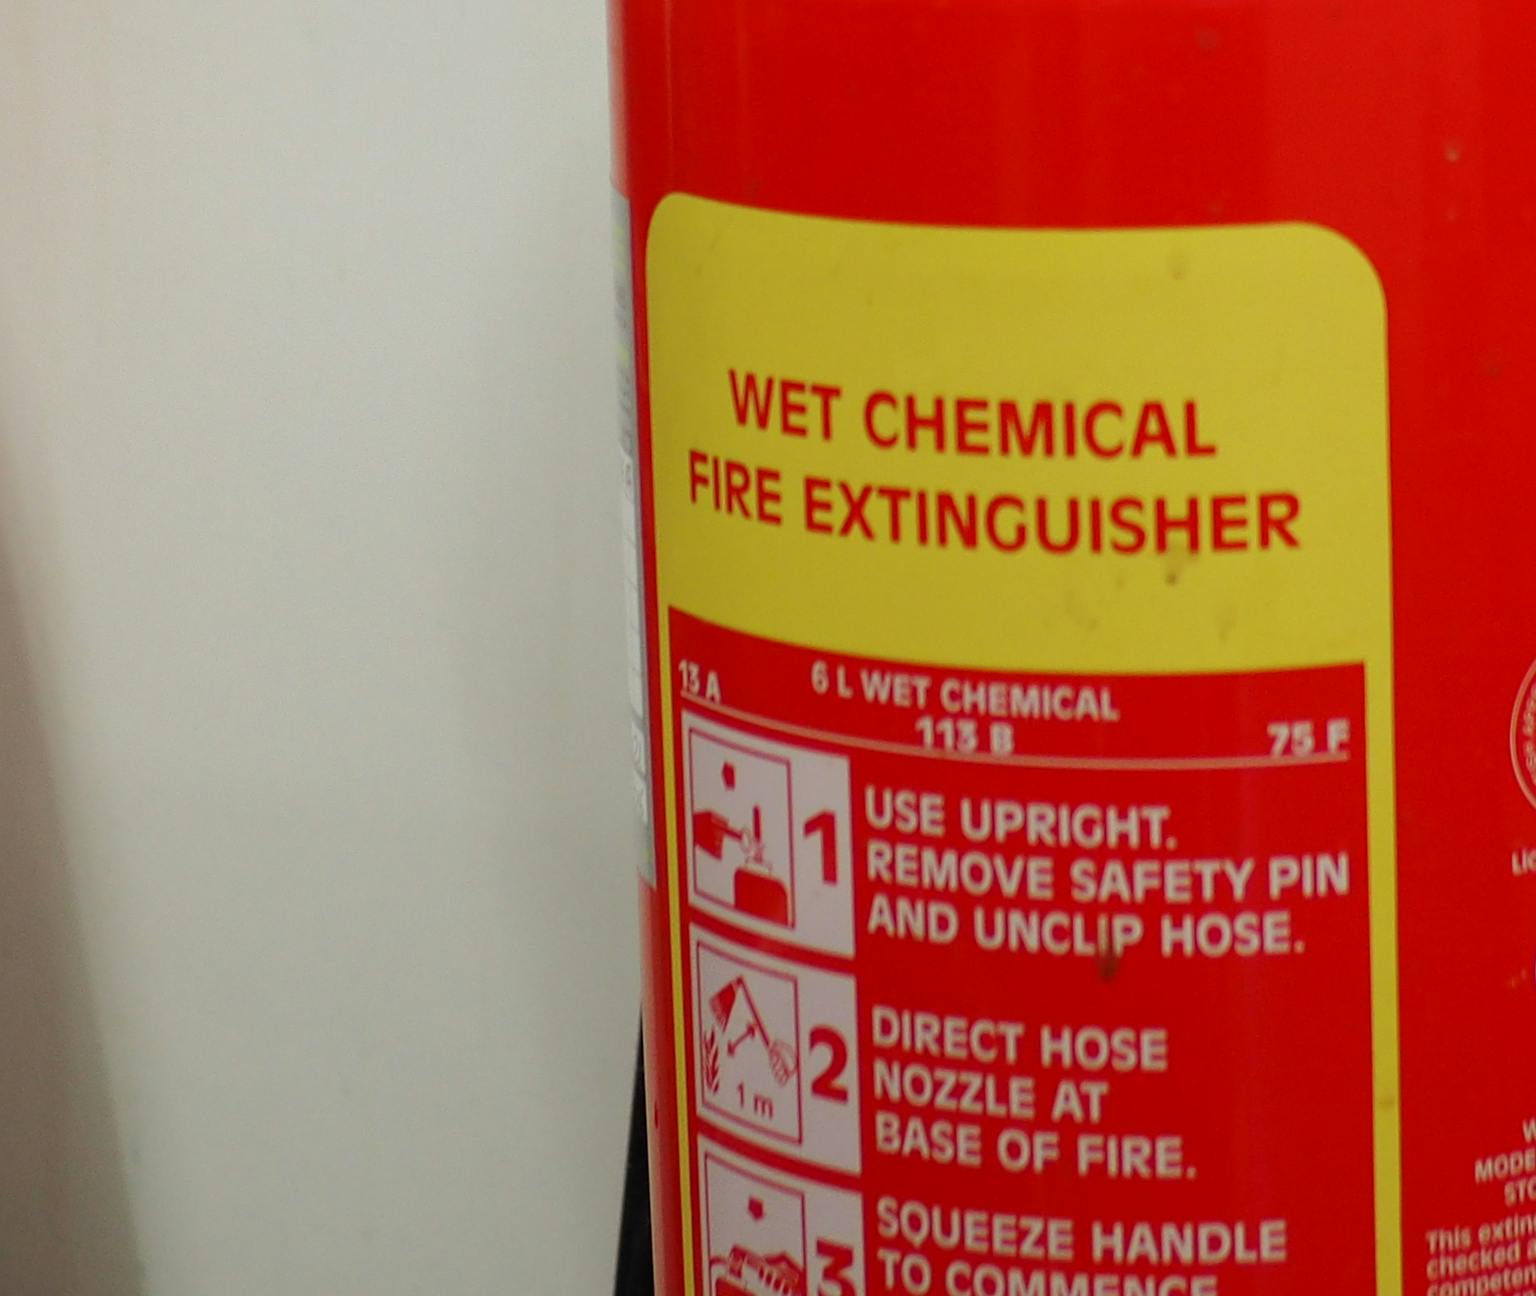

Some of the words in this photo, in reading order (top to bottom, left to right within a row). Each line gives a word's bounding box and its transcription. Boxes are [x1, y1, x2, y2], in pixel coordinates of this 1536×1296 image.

[728, 368, 842, 442] WET
[864, 390, 1218, 460] CHEMICAL
[689, 451, 783, 526] FIRE
[804, 476, 1302, 556] EXTINGUISHER
[678, 659, 700, 696] 13
[705, 671, 722, 702] A
[811, 660, 830, 695] 6
[837, 665, 853, 699] L
[860, 668, 932, 709] WET
[939, 677, 1121, 722] CHEMICAL
[916, 716, 978, 753] 113
[989, 722, 1015, 755] B
[1267, 721, 1313, 756] 75
[1326, 718, 1350, 754] F
[802, 810, 838, 887] 1
[864, 784, 946, 838] USE
[960, 796, 1179, 851] UPRIGHT.
[867, 838, 1054, 902] REMOVE
[1070, 856, 1255, 904] SAFETY
[1268, 851, 1350, 901] PIN
[866, 892, 959, 944] AND
[973, 905, 1145, 957] UNCLIP
[1160, 909, 1306, 957] HOSE.
[808, 1022, 851, 1105] 2
[871, 1004, 1025, 1066] DIRECT
[1040, 1023, 1170, 1074] HOSE
[752, 1093, 775, 1120] m
[872, 1057, 1037, 1122] NOZZLE
[1050, 1077, 1111, 1126] AT
[875, 1109, 984, 1168] BASE
[997, 1128, 1061, 1175] OF
[1076, 1132, 1198, 1182] FIRE.
[876, 1194, 1076, 1263] SQUEEZE
[1090, 1217, 1288, 1267] HANDLE
[1425, 1225, 1471, 1255] This
[1426, 1239, 1522, 1282] checked
[815, 1238, 857, 1296] 3
[877, 1248, 932, 1296] TO
[945, 1260, 1218, 1296] COMMENCE
